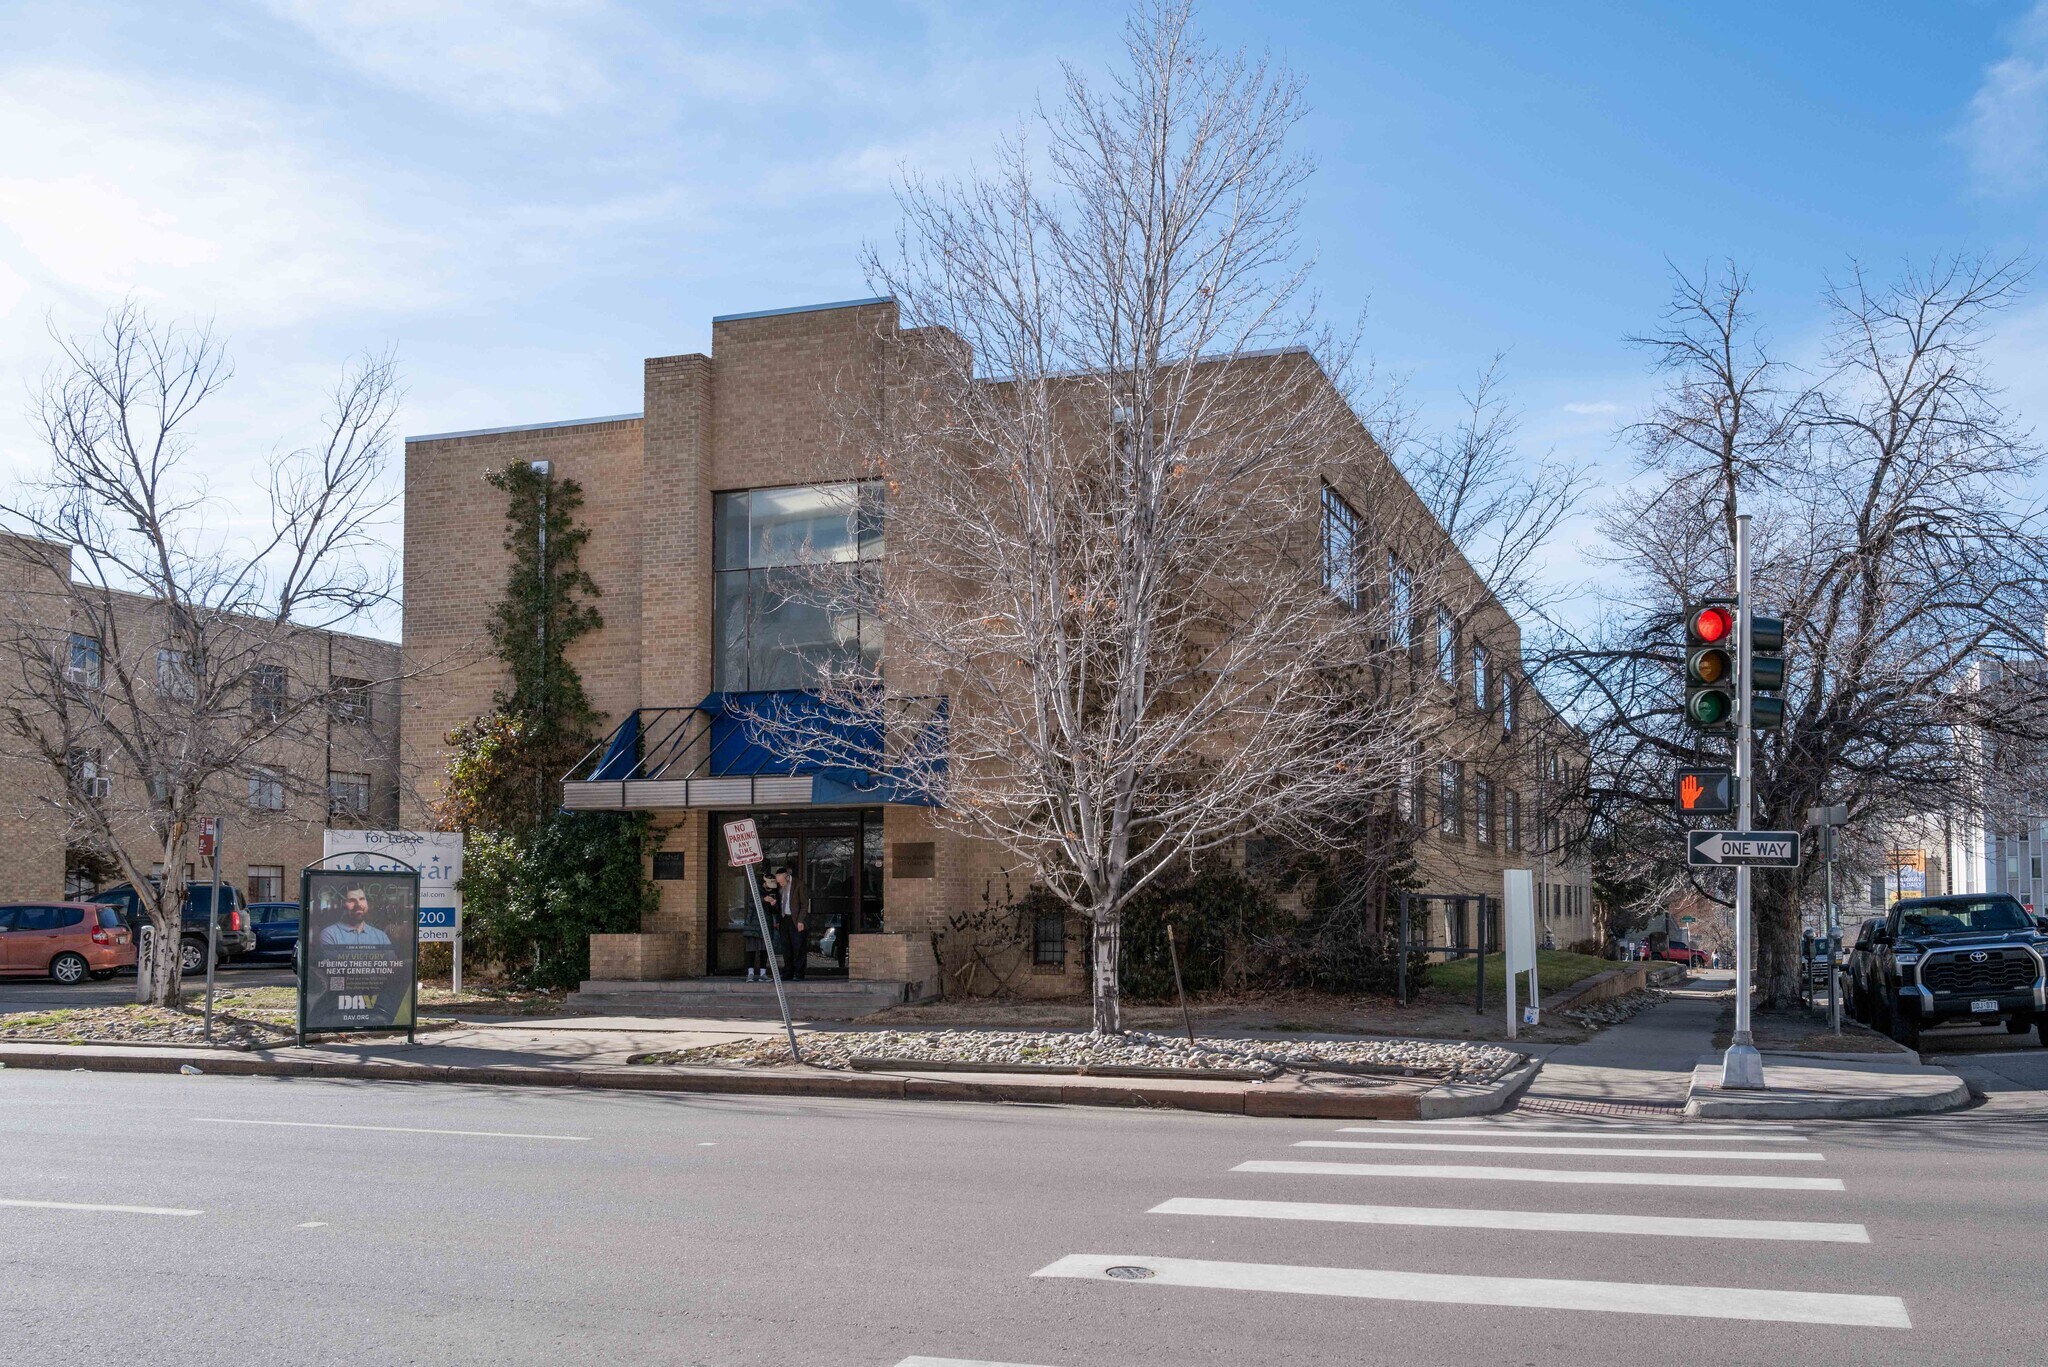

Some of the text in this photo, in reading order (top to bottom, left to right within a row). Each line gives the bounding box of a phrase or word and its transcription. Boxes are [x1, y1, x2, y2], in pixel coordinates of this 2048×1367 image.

[735, 823, 746, 832] NO
[366, 832, 424, 844] For Lease
[729, 831, 756, 843] PARKING
[738, 847, 753, 855] TIME
[1722, 842, 1787, 856] ONE WAY
[338, 994, 378, 1009] DAV
